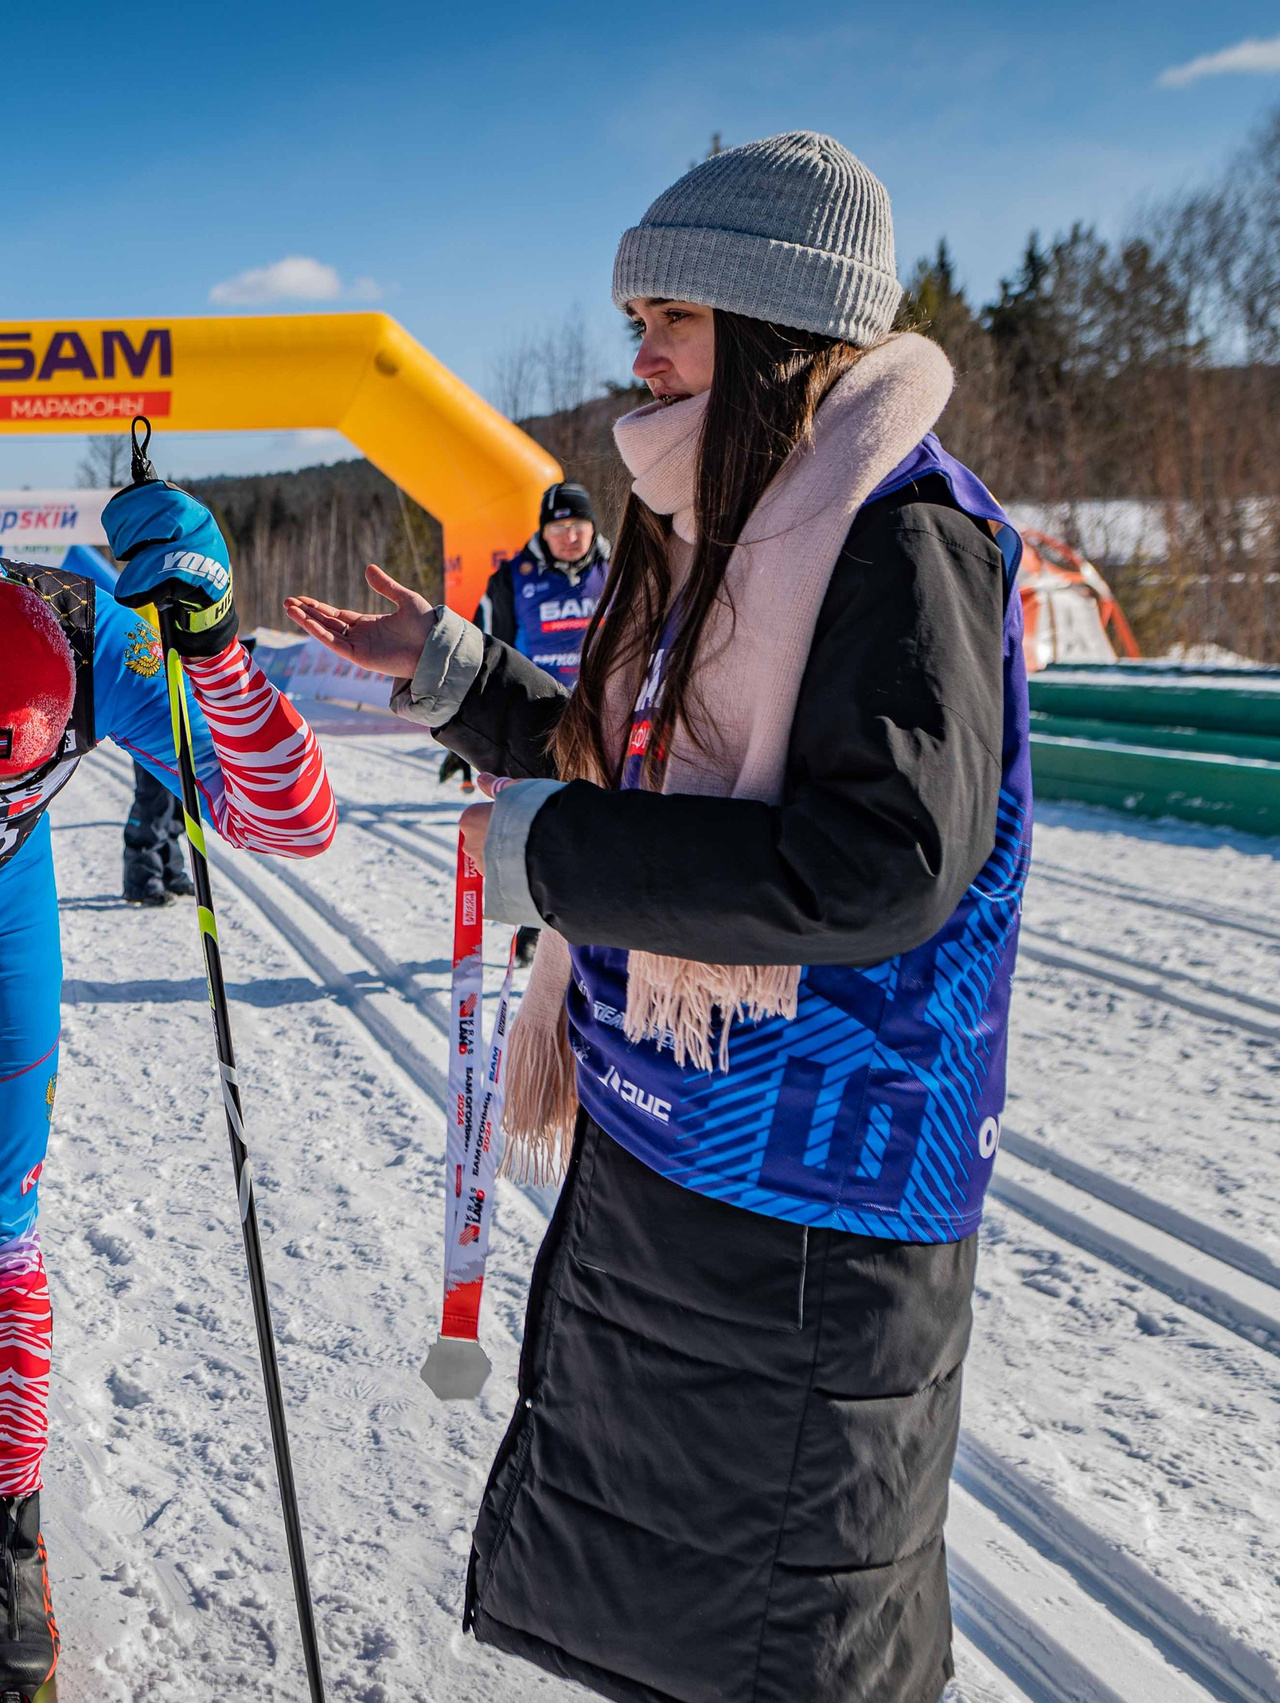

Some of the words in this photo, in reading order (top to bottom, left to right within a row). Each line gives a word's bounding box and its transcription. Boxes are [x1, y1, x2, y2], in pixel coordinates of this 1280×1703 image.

[10, 396, 146, 419] МАРАФОНЫ
[488, 1046, 500, 1082] БАМ
[465, 1066, 473, 1095] БАМ
[457, 1093, 465, 1126] 2024
[483, 1121, 492, 1153] 2024
[472, 1148, 482, 1177] БАМ
